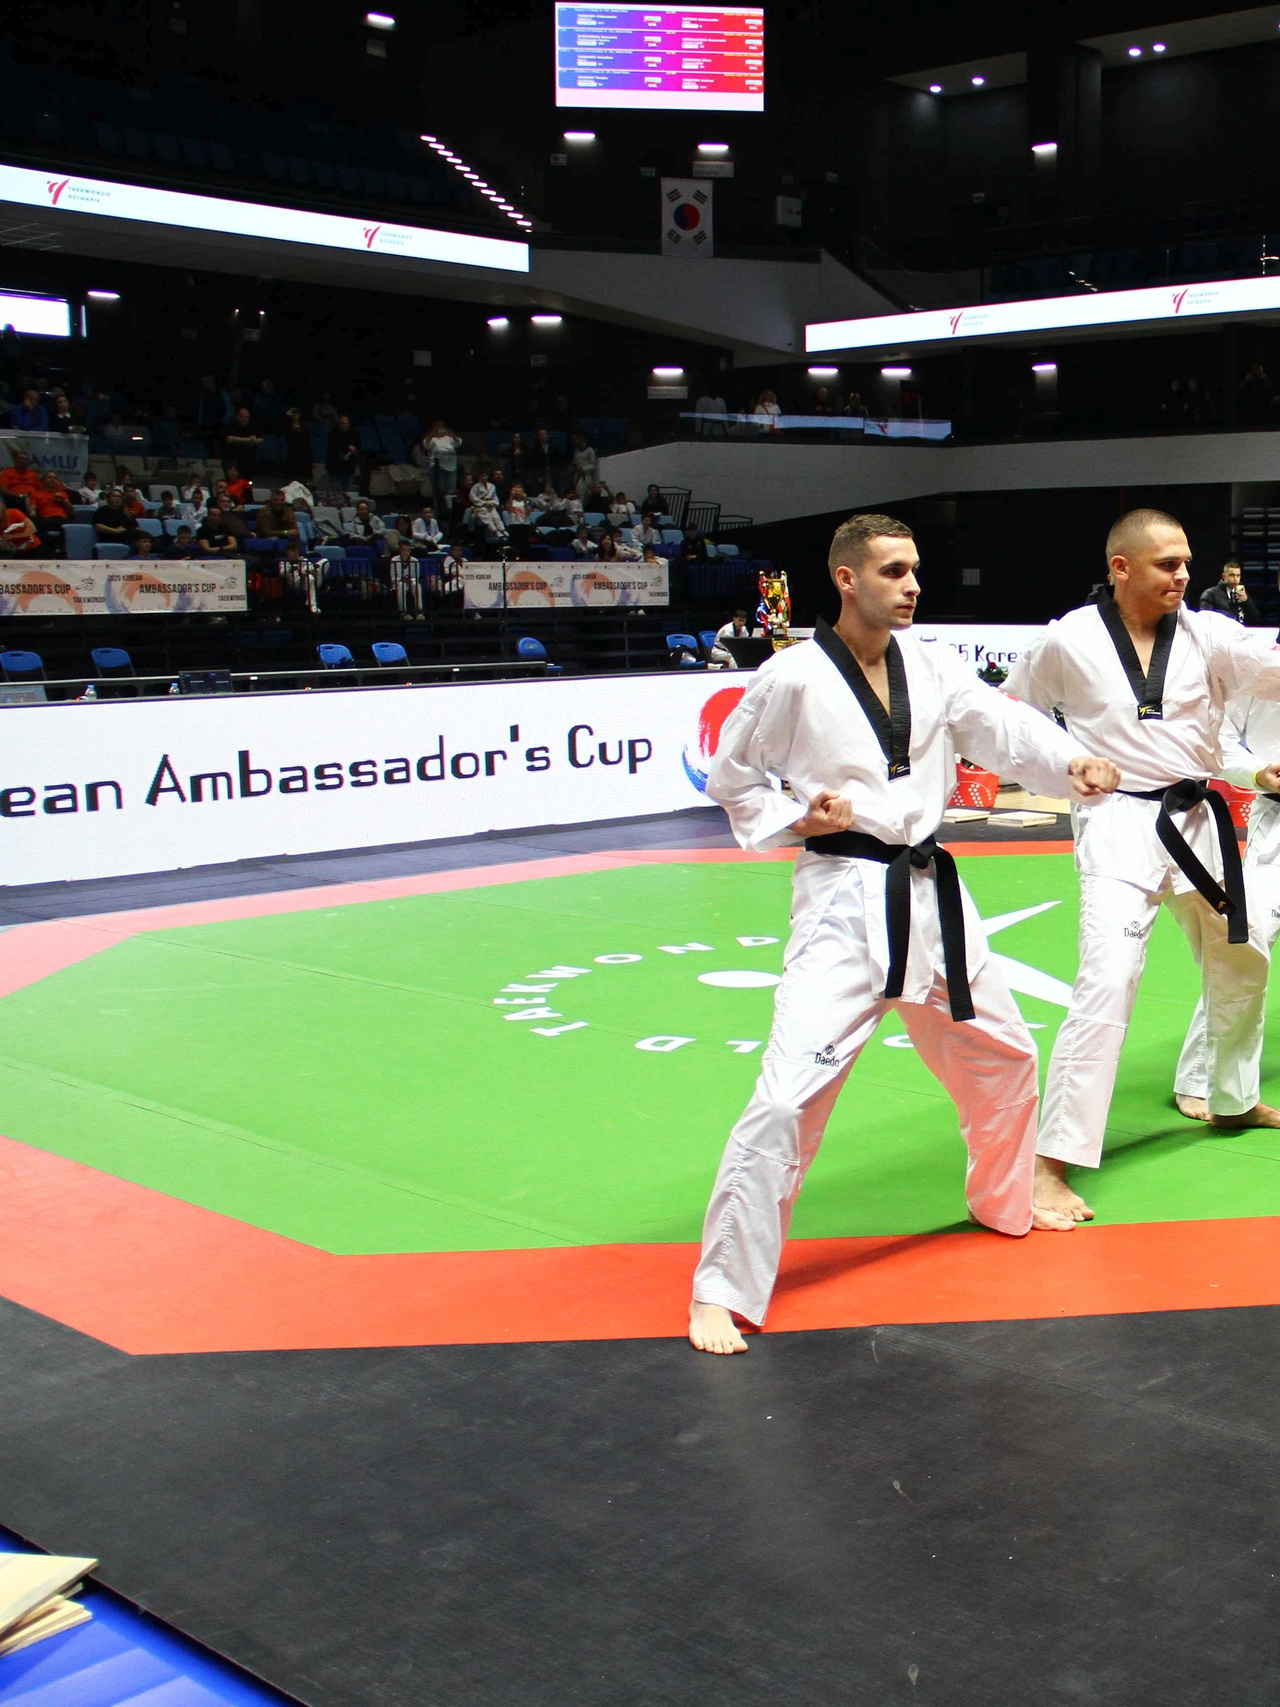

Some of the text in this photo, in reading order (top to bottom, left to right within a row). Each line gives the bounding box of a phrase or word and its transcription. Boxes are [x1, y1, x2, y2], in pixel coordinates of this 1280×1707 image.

[68, 186, 111, 197] TAEKWONDO
[54, 583, 71, 595] CUP
[139, 583, 217, 594] AMBASSADOR'S CUP
[488, 581, 534, 591] AMBSSADOR'S
[146, 724, 551, 807] Ambassador's
[567, 725, 652, 774] Cup
[815, 1052, 840, 1067] Daedo
